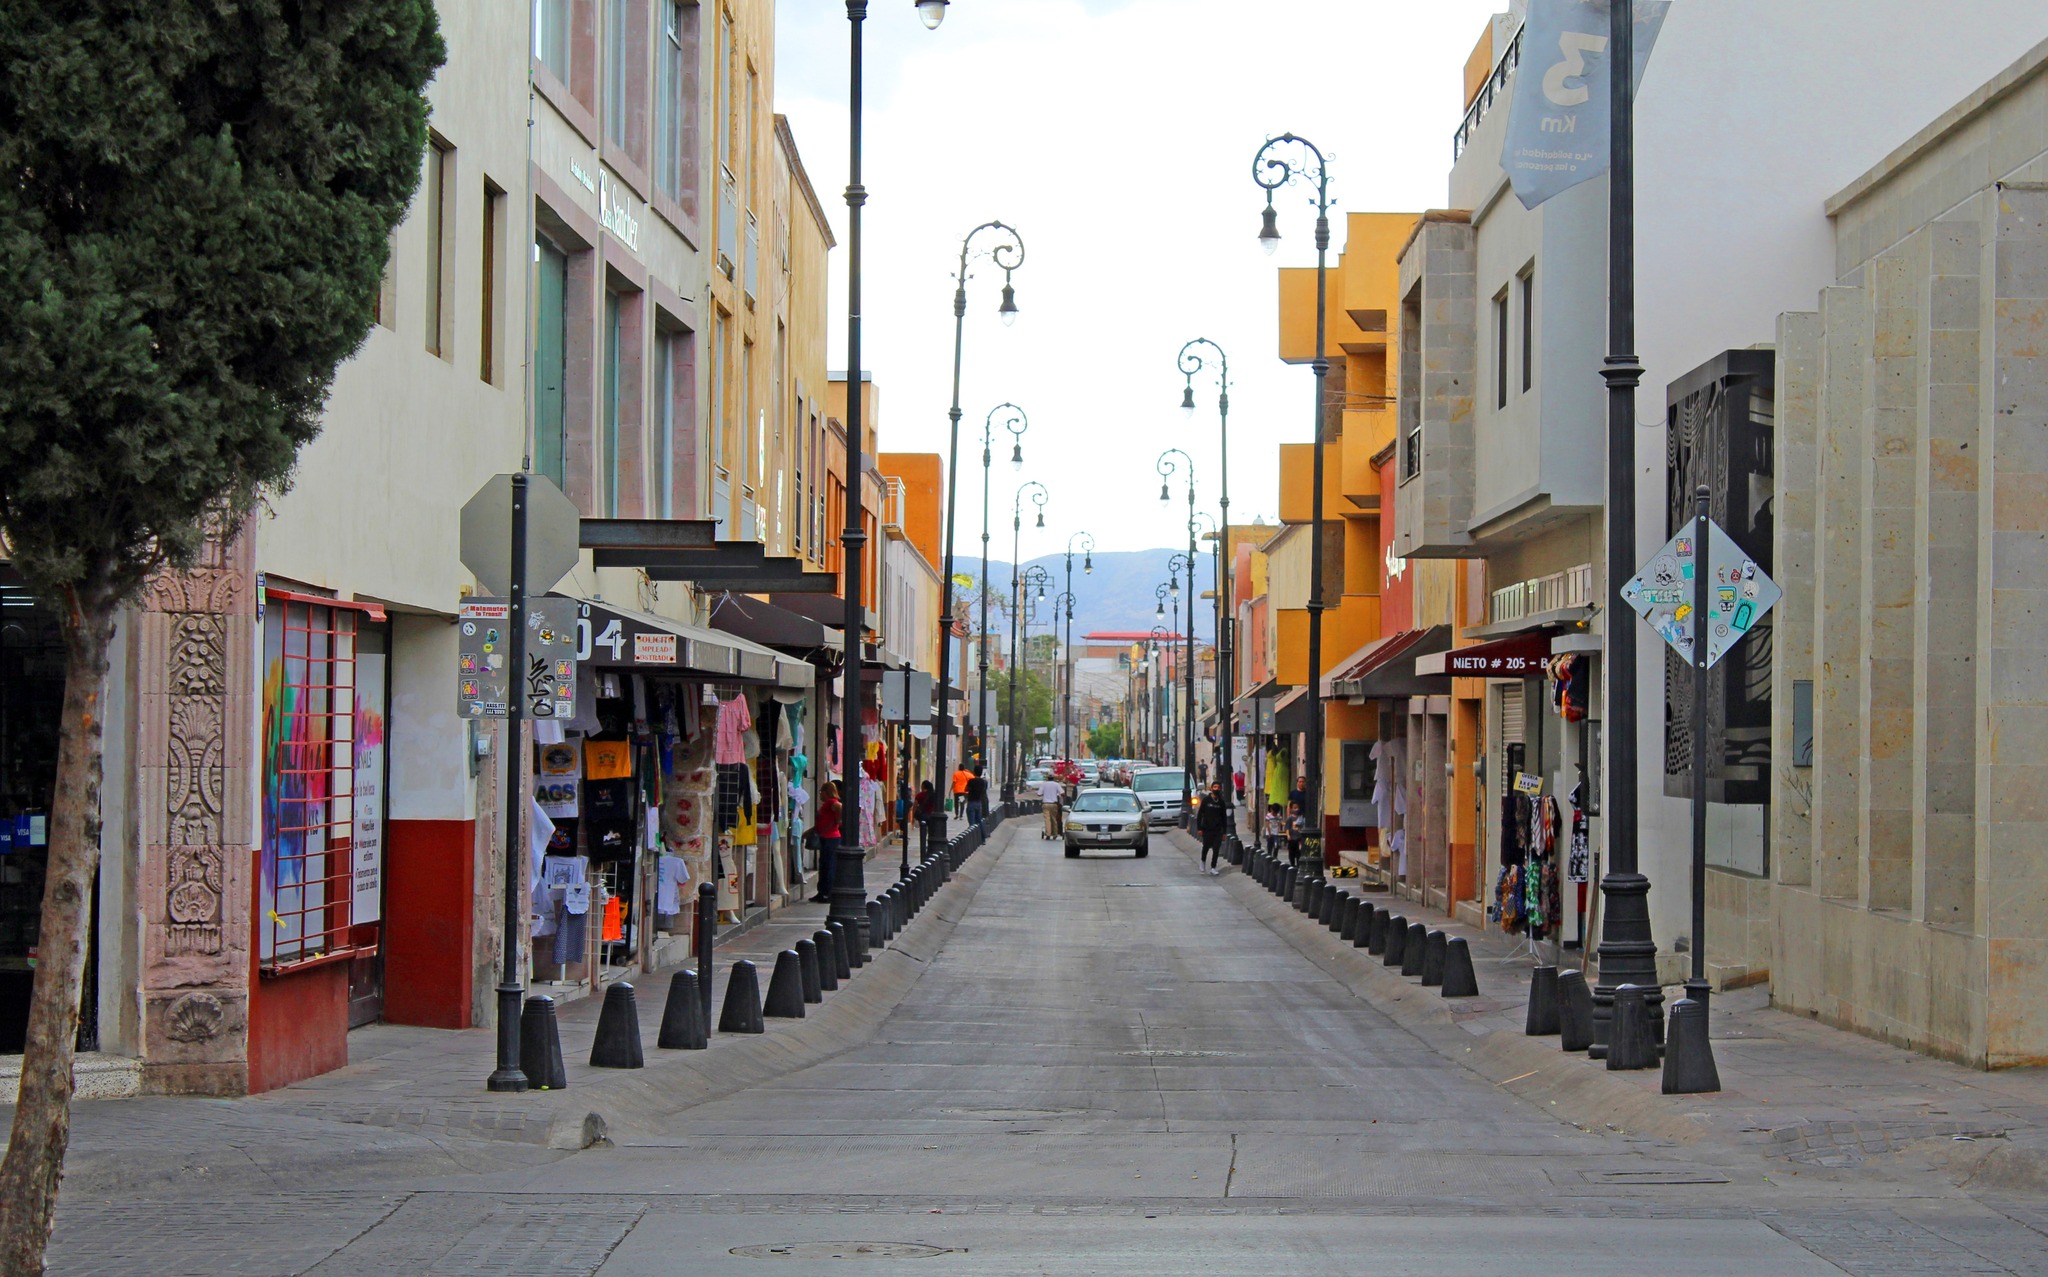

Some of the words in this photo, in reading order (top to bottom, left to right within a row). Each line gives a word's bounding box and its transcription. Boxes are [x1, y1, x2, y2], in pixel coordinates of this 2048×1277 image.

[1490, 658, 1502, 669] #
[1506, 657, 1526, 669] 205
[535, 784, 576, 802] AGS
